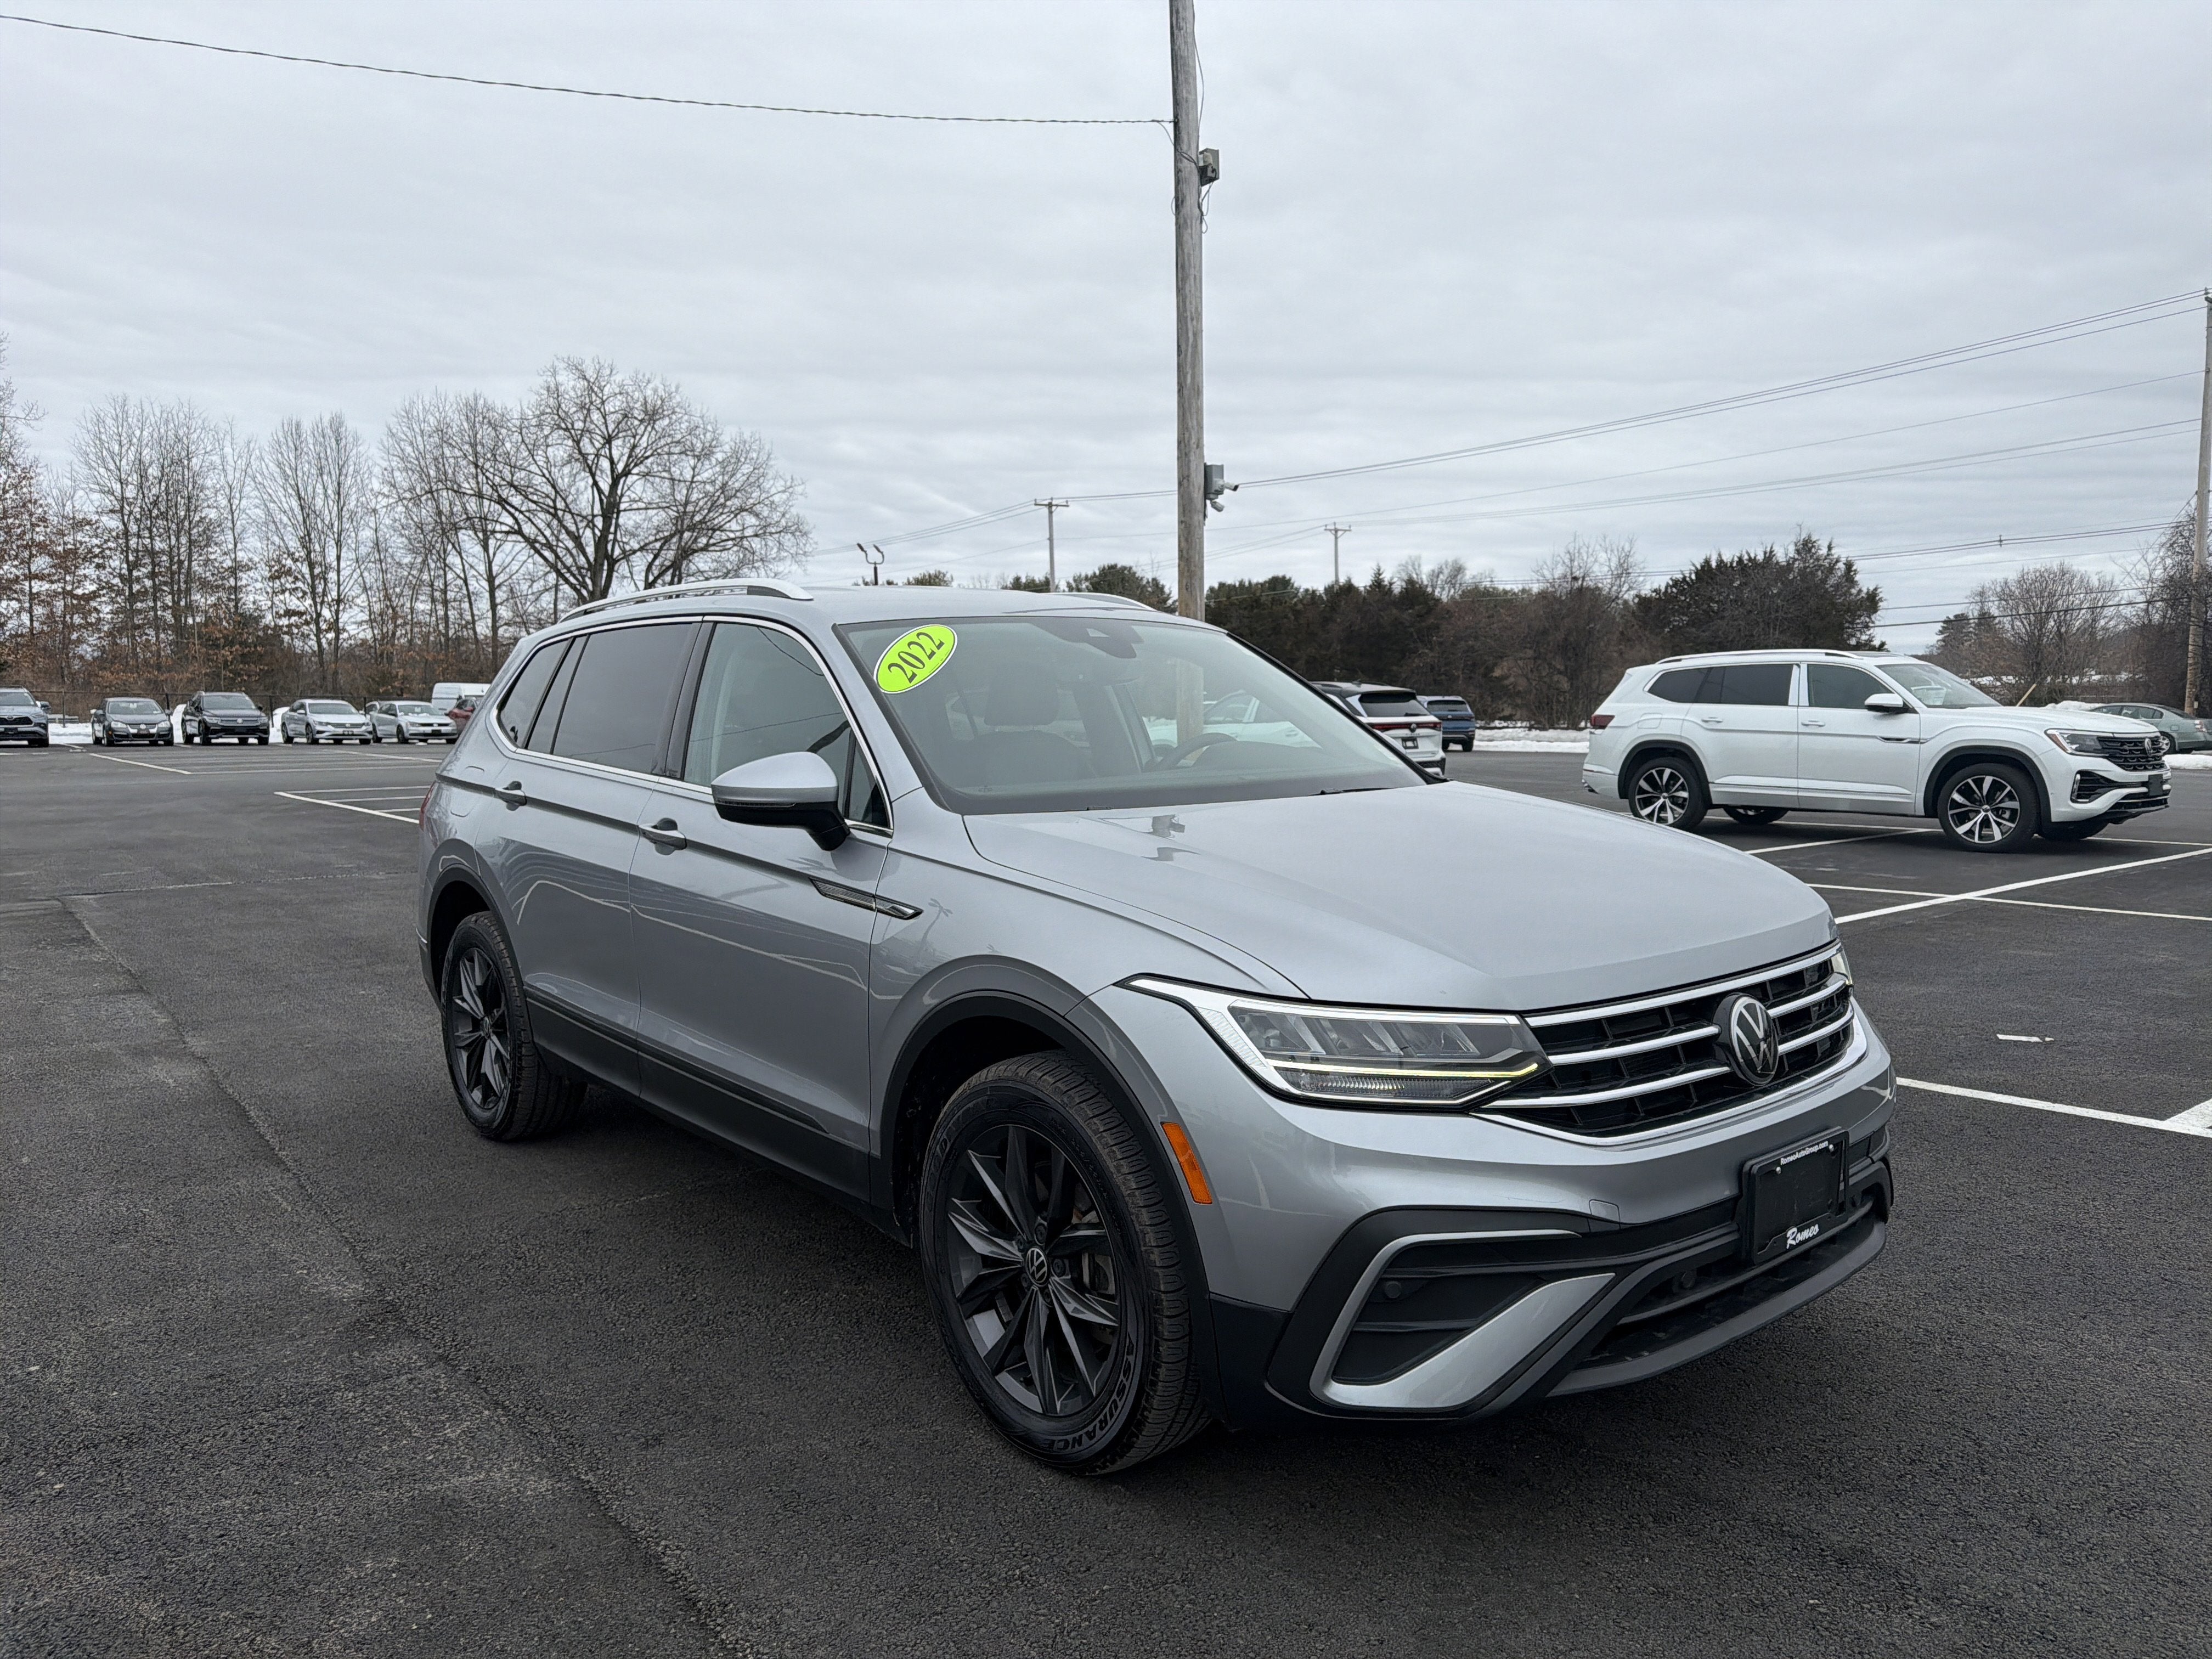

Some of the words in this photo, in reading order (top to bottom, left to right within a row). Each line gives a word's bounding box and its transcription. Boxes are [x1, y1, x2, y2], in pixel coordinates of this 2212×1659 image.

[888, 632, 945, 684] 2022
[1780, 1141, 1829, 1166] RomeoAutoGroup.com
[1786, 1224, 1819, 1249] Romeo
